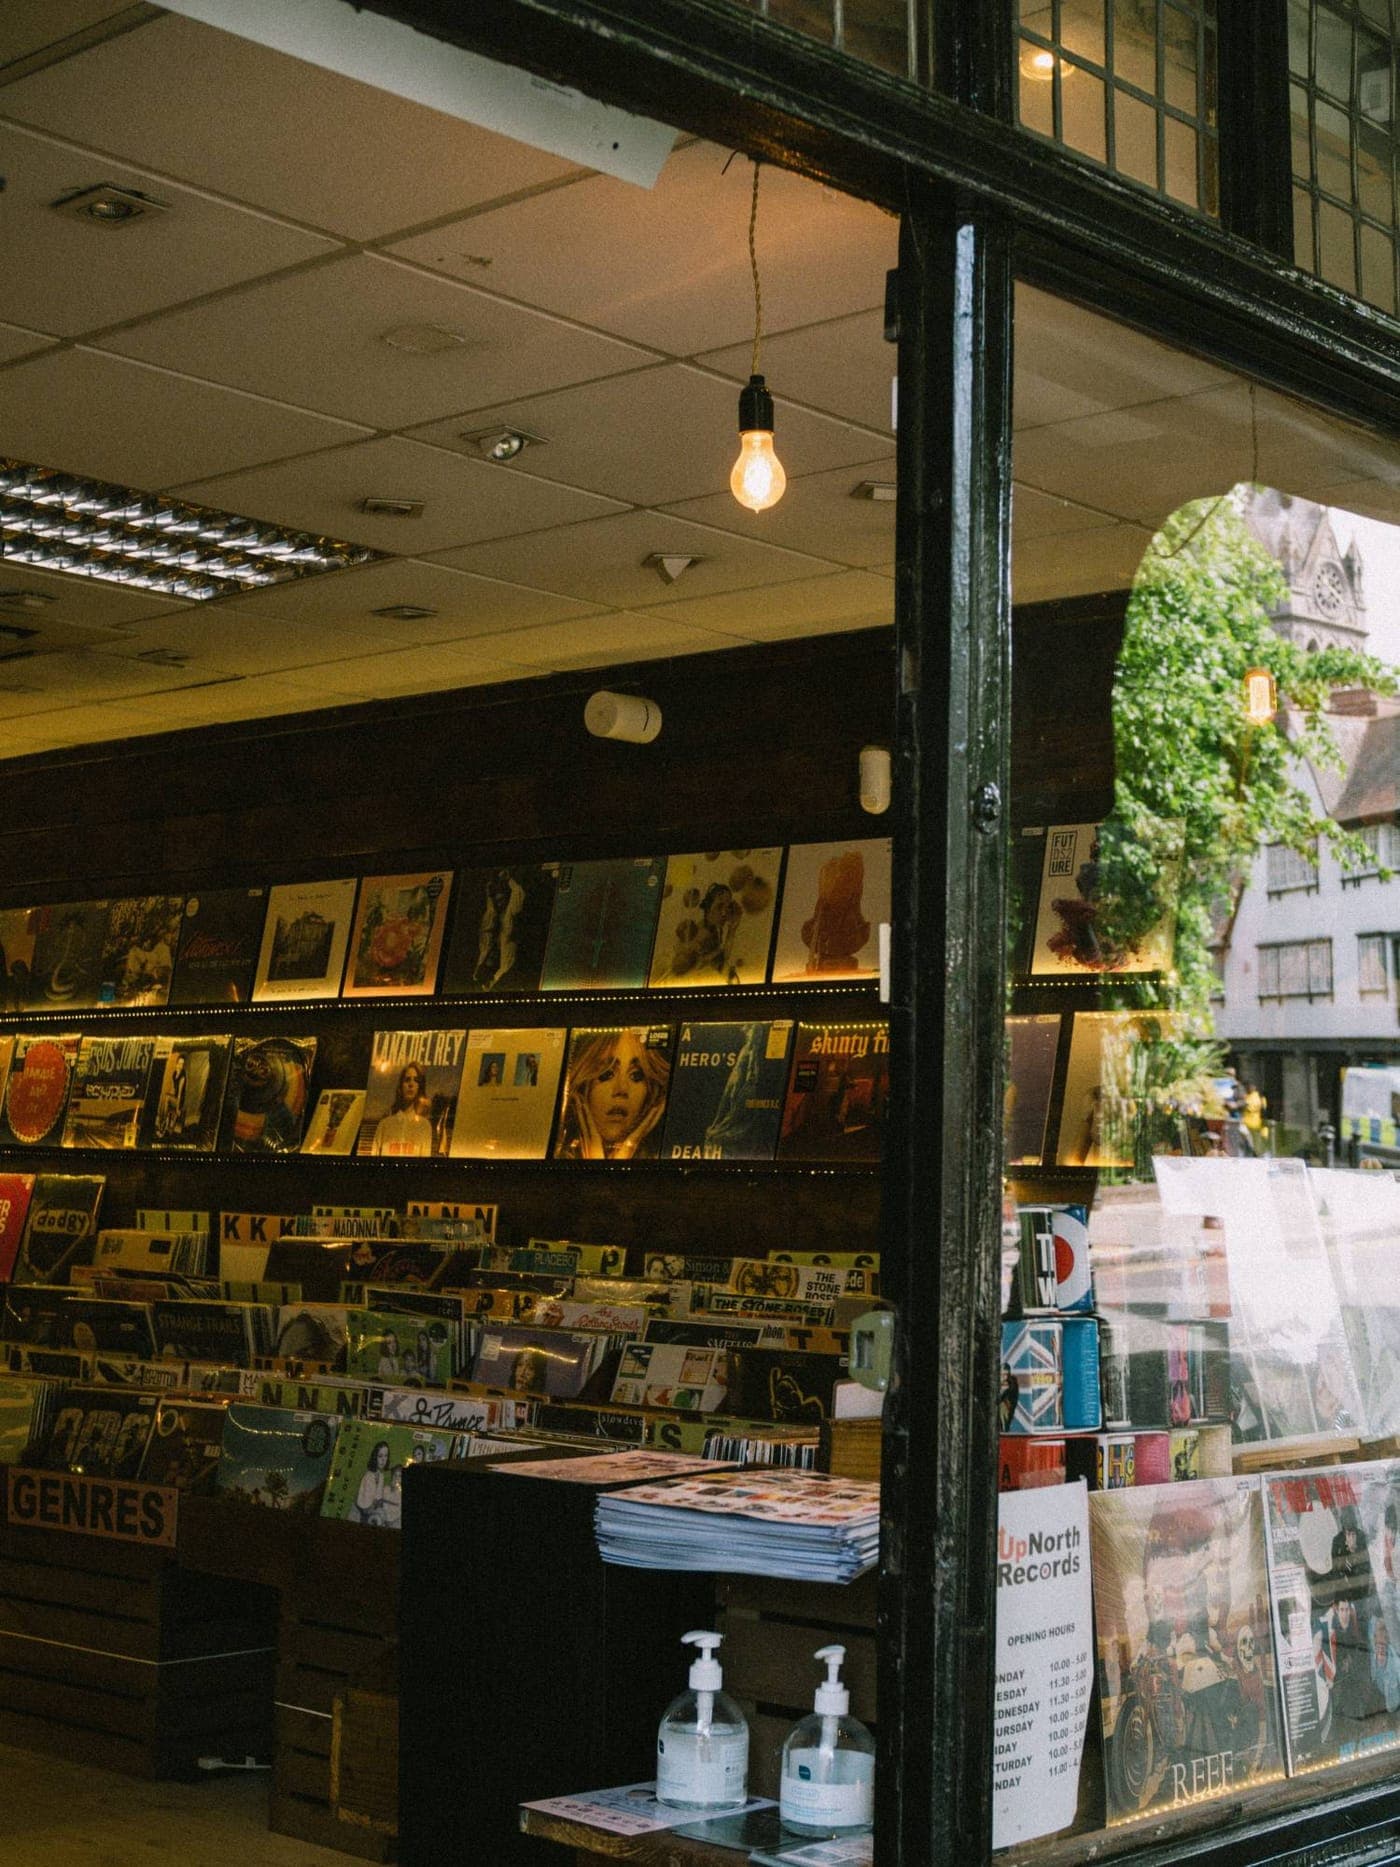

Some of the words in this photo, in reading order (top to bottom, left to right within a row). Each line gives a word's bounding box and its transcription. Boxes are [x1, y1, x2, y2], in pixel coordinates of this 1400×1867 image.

[1054, 834, 1074, 848] FUT
[1051, 860, 1071, 873] URE
[681, 1027, 692, 1042] A
[432, 1032, 465, 1067] REY
[679, 1052, 737, 1068] HERO'S
[671, 1145, 723, 1160] DEATH
[37, 1209, 87, 1233] dodgy
[333, 1217, 378, 1238] MADONNA
[533, 1250, 576, 1267] PLACEBO
[806, 1281, 842, 1295] STONE
[815, 1271, 837, 1284] THE
[714, 1298, 738, 1310] THE
[740, 1299, 783, 1313] STONE
[13, 1475, 165, 1539] GENRES
[996, 1551, 1081, 1588] Records
[1007, 1629, 1048, 1647] OPENING
[1048, 1622, 1076, 1638] HOURS
[996, 1669, 1025, 1684] NDAY
[1049, 1658, 1071, 1673] 10.00
[996, 1686, 1028, 1702] ESDAY
[1049, 1676, 1070, 1690] 11.30
[996, 1700, 1041, 1720] DNESDAY
[1049, 1693, 1070, 1707] 11.30
[995, 1719, 1034, 1738] URSDAY
[1048, 1710, 1070, 1725] 10.00
[994, 1741, 1018, 1756] IDAY
[1048, 1727, 1069, 1742] 10.00
[994, 1755, 1033, 1774] TURDAY
[1048, 1744, 1069, 1760] 10.00
[994, 1775, 1022, 1791] NDAY
[1048, 1762, 1068, 1777] 11.00
